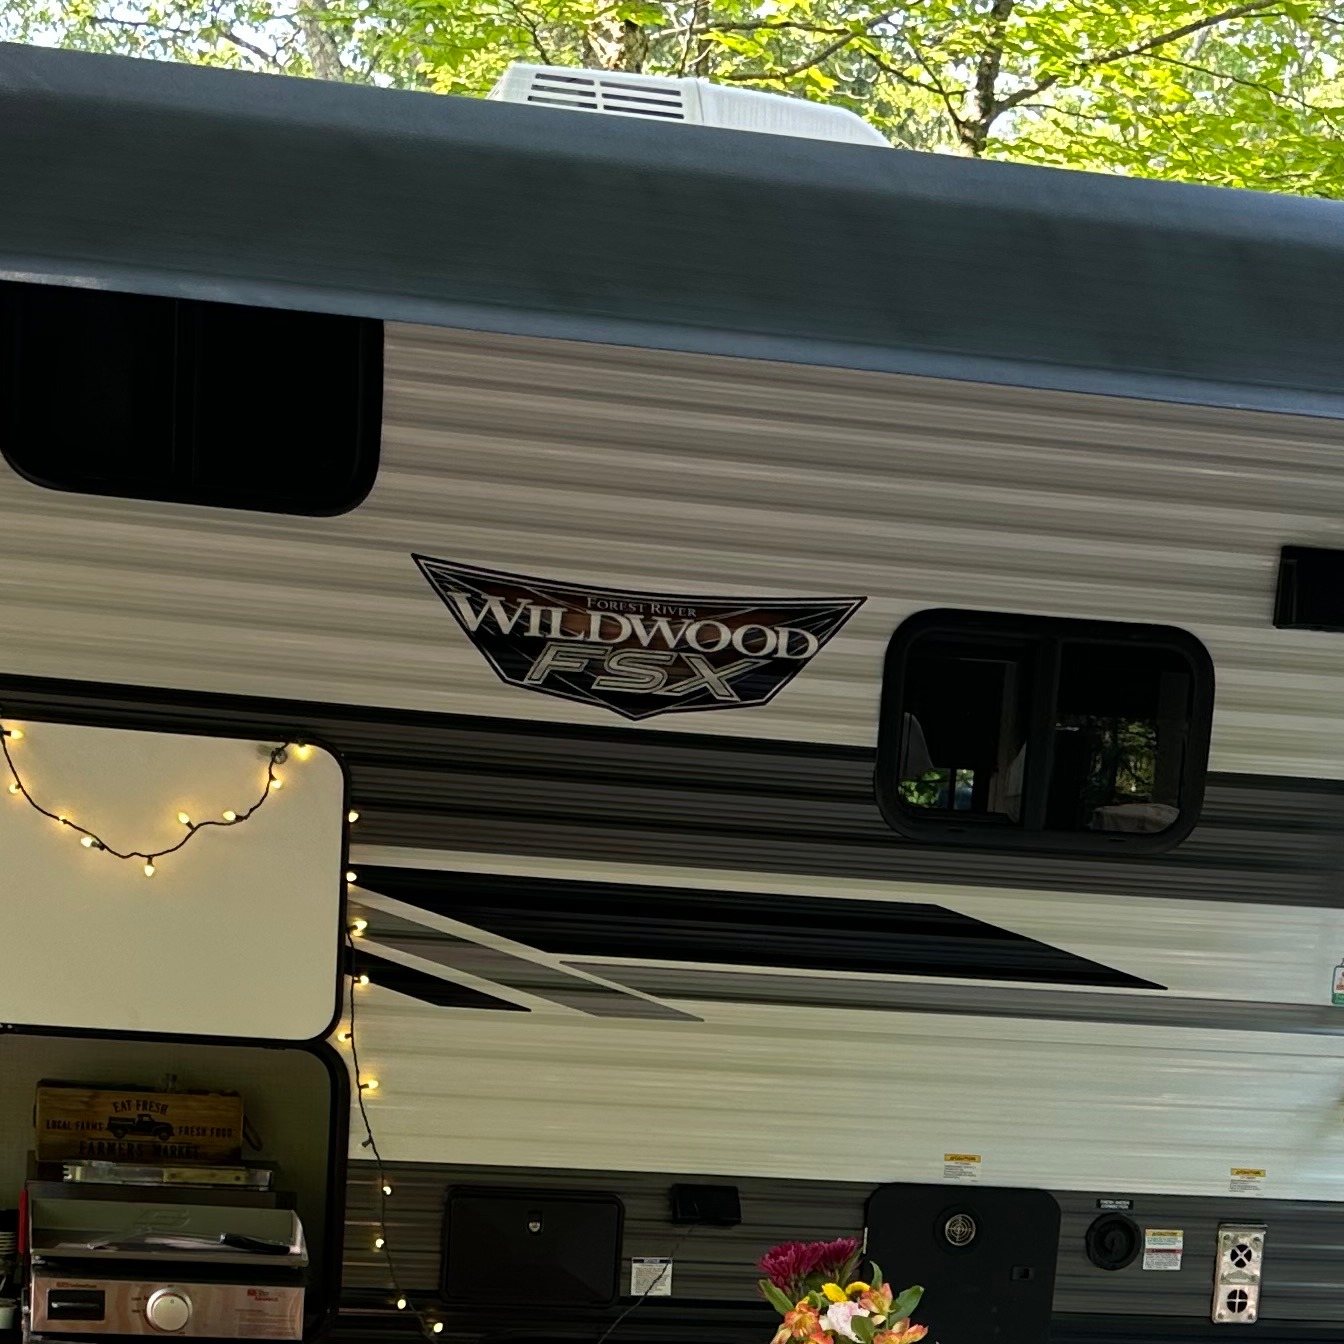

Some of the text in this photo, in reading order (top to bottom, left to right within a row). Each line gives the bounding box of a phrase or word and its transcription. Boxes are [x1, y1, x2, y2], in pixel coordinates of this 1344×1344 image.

[587, 598, 697, 618] FOREST RIVER
[447, 591, 819, 660] WILDWOOD
[524, 642, 771, 702] FSX
[112, 1099, 169, 1115] EAT FRESH
[46, 1119, 103, 1132] LOCAL FARMS
[178, 1127, 233, 1138] FRESH FOOD
[79, 1140, 200, 1159] FARMERS MARKET
